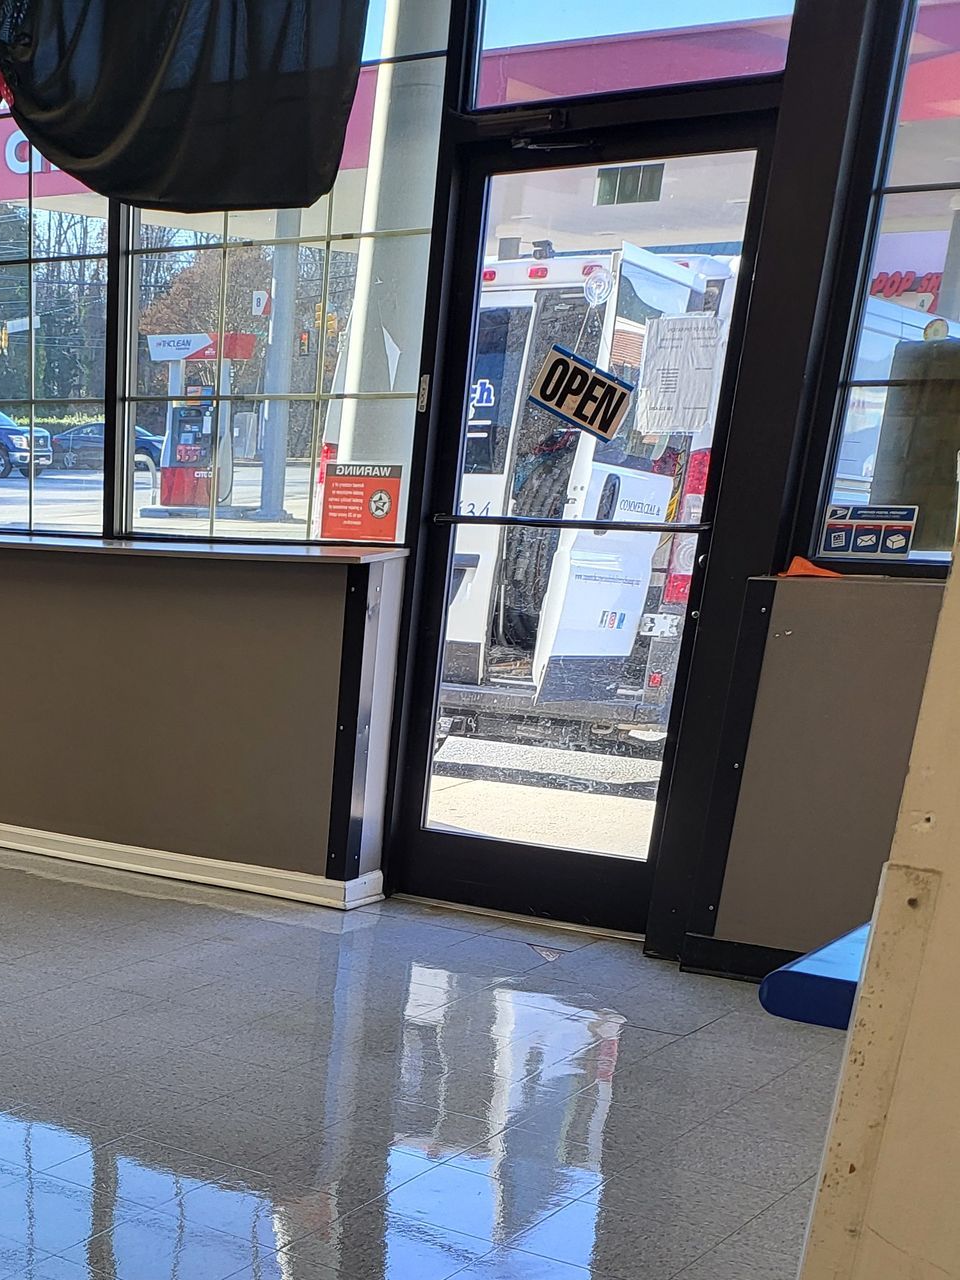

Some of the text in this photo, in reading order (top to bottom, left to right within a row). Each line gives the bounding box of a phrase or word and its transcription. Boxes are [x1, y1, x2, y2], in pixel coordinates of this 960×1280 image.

[869, 271, 916, 298] POP
[256, 297, 261, 307] 8
[540, 358, 627, 433] OPEN
